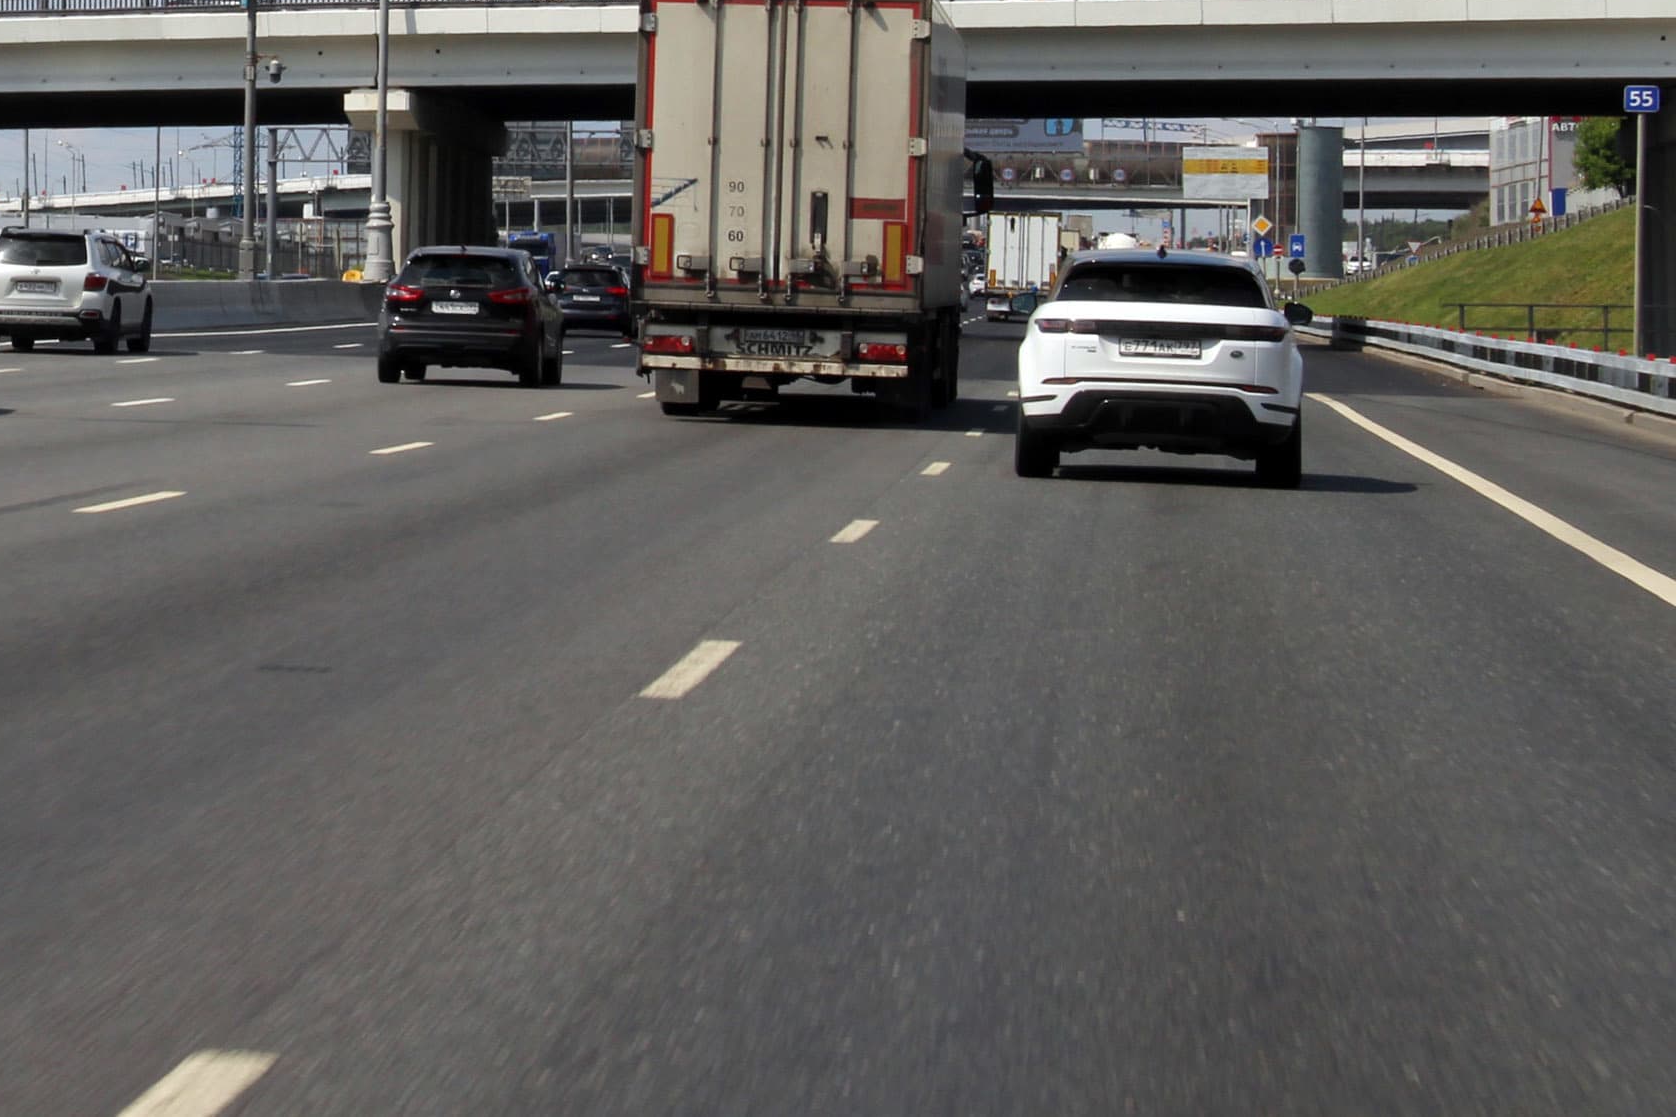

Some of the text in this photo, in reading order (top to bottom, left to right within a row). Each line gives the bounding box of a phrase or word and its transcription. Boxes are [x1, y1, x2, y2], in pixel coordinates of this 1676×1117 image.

[1629, 90, 1654, 107] 55
[1552, 122, 1579, 132] АВТ
[728, 181, 745, 193] 90
[728, 205, 745, 218] 70
[728, 230, 744, 242] 60
[735, 343, 814, 355] SCHMITZ
